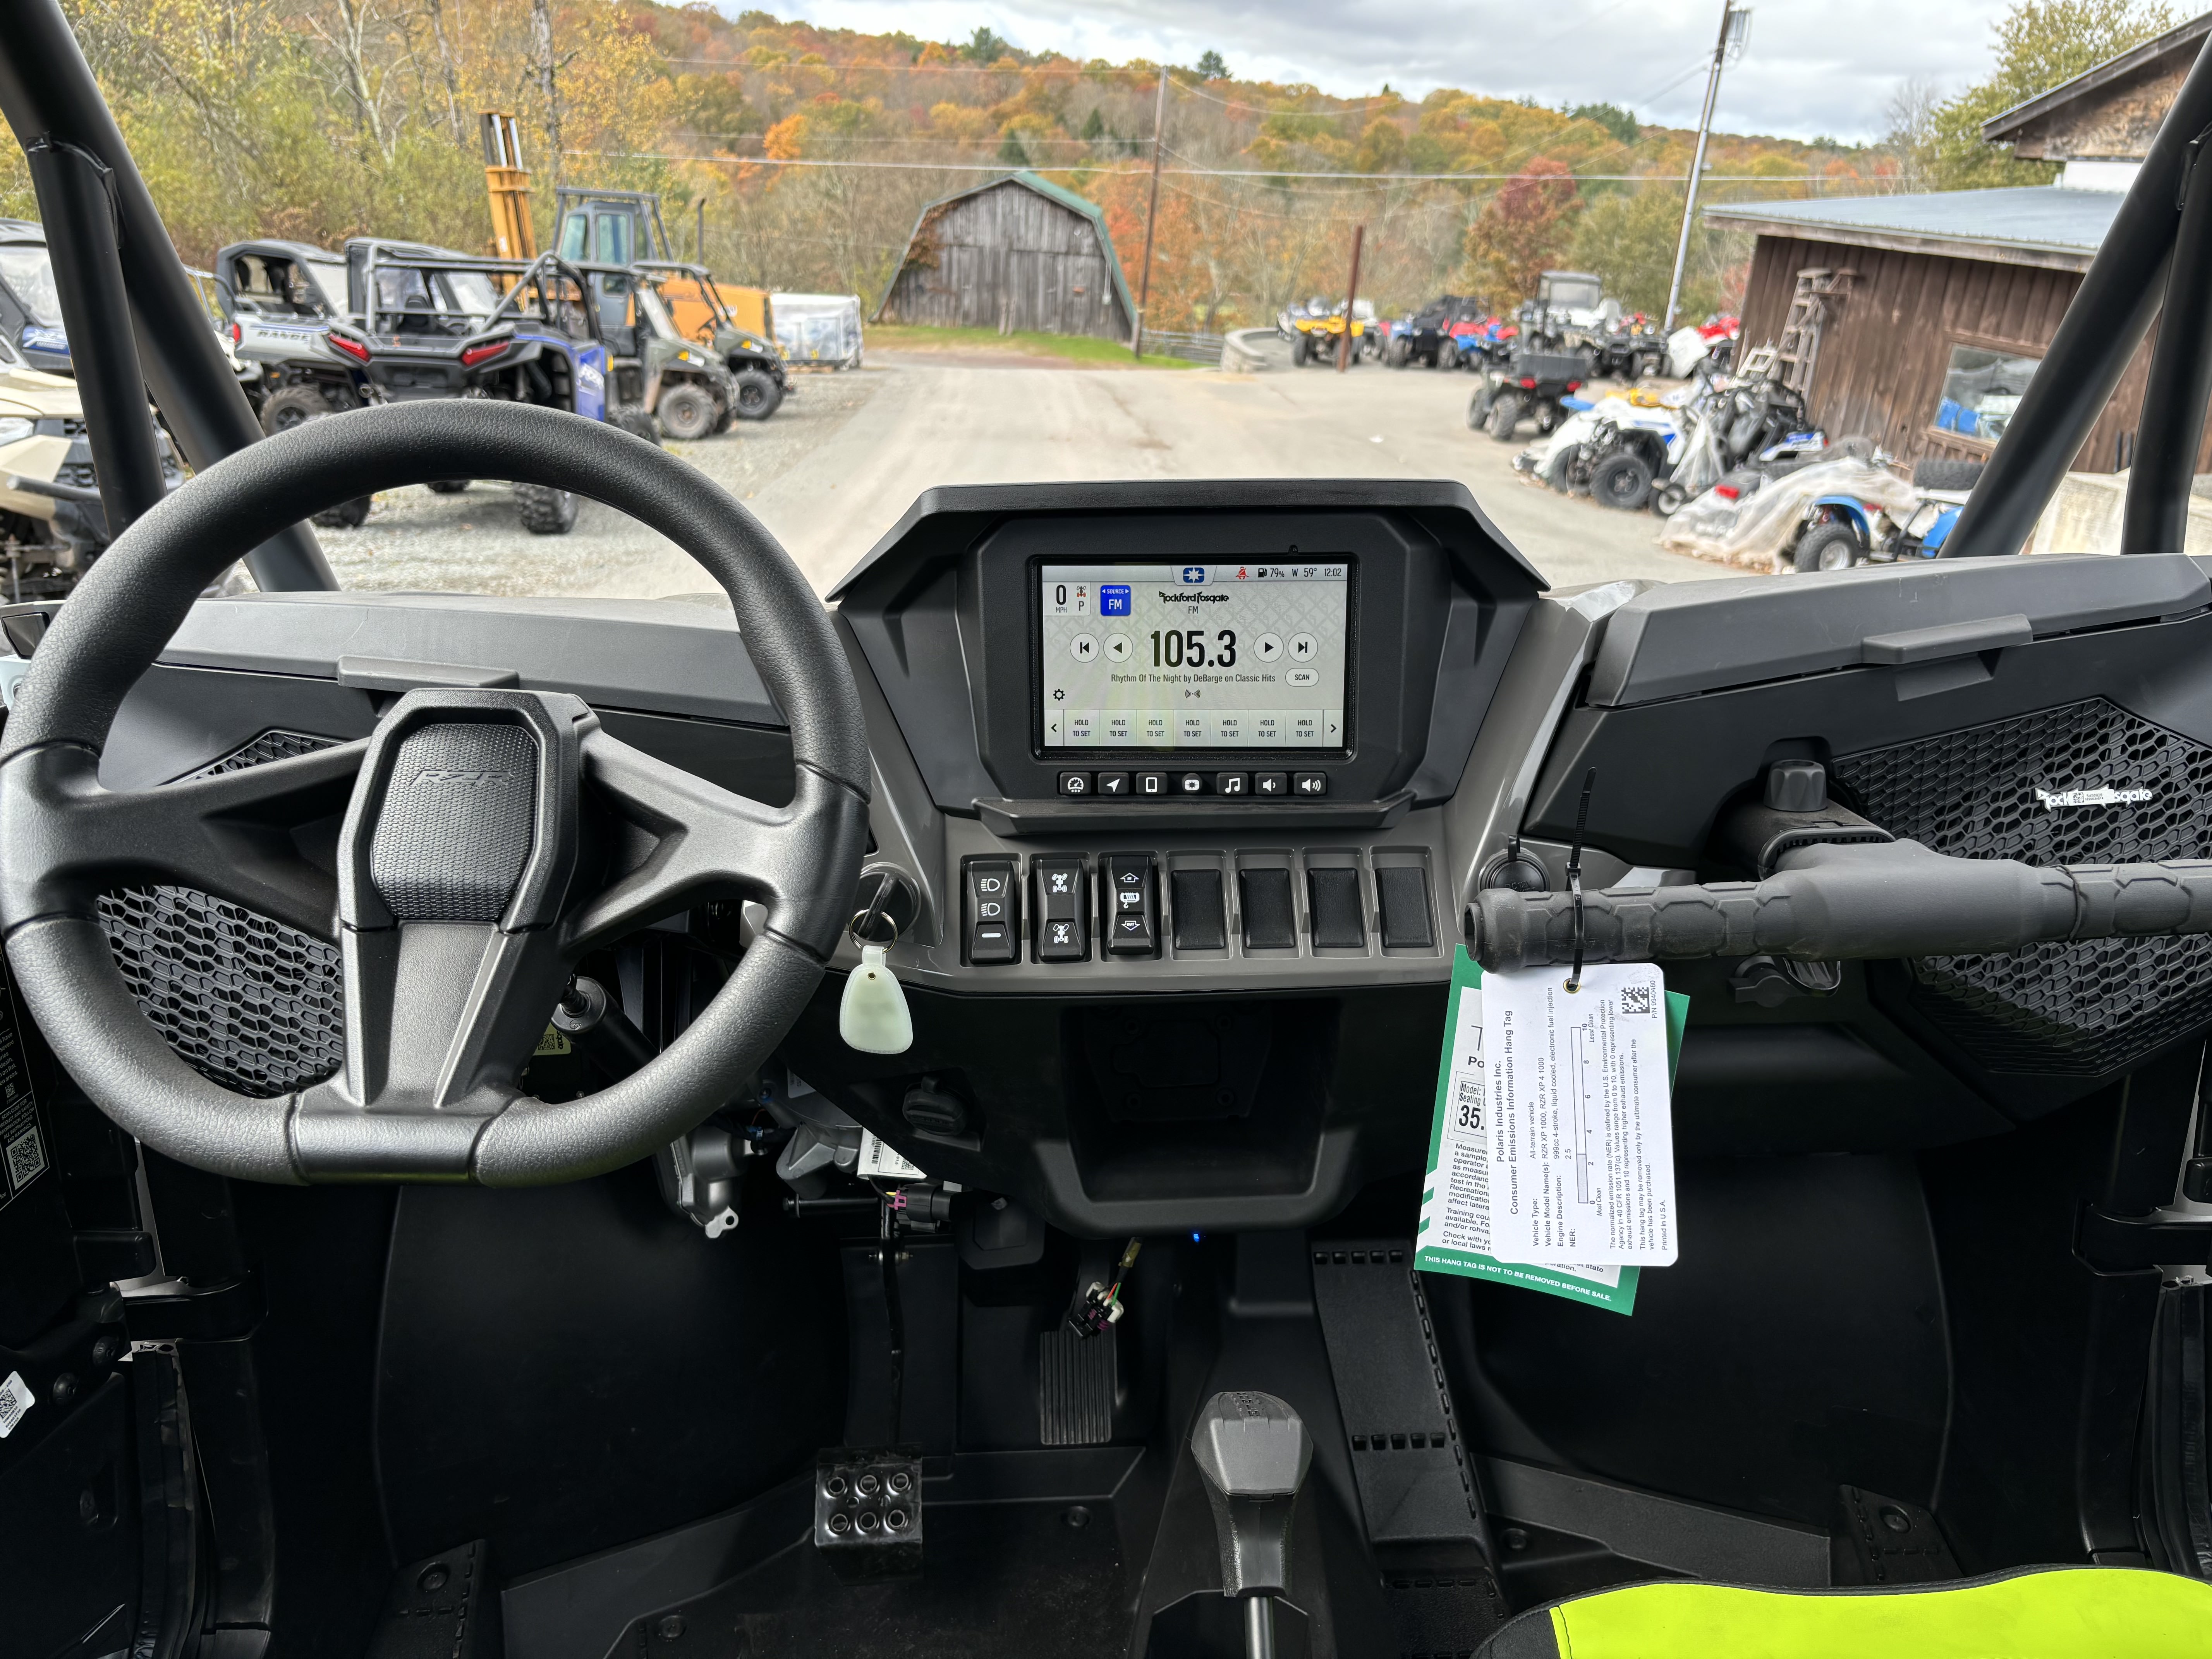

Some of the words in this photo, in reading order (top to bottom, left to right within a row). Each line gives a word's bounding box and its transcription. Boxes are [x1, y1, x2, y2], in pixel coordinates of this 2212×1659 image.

[1270, 568, 1285, 577] 79%
[1292, 568, 1298, 577] W
[1304, 568, 1317, 577] 59°
[1325, 568, 1341, 576] 12:02
[1056, 585, 1066, 605] 0
[1079, 601, 1084, 611] P
[1109, 599, 1121, 609] FM
[1151, 630, 1236, 667] 105.3
[1111, 674, 1136, 684] Rhythm
[1163, 674, 1181, 684] Night
[1184, 674, 1191, 684] by
[1194, 674, 1222, 684] DeBarge
[1503, 1011, 1513, 1027] Tag
[1504, 1030, 1513, 1053] Hang
[1505, 1057, 1514, 1110] Information
[1539, 1082, 1545, 1092] XP
[1494, 1080, 1503, 1126] Industries
[1507, 1113, 1516, 1162] Emissions
[1540, 1132, 1547, 1142] XP
[1496, 1130, 1504, 1162] Polaris
[1454, 1158, 1484, 1168] operator
[1446, 1207, 1474, 1218] Training
[1617, 1209, 1623, 1218] 40
[1445, 1215, 1478, 1225] available.
[1525, 1274, 1560, 1286] REMOVED
[1562, 1283, 1590, 1295] BEFORE
